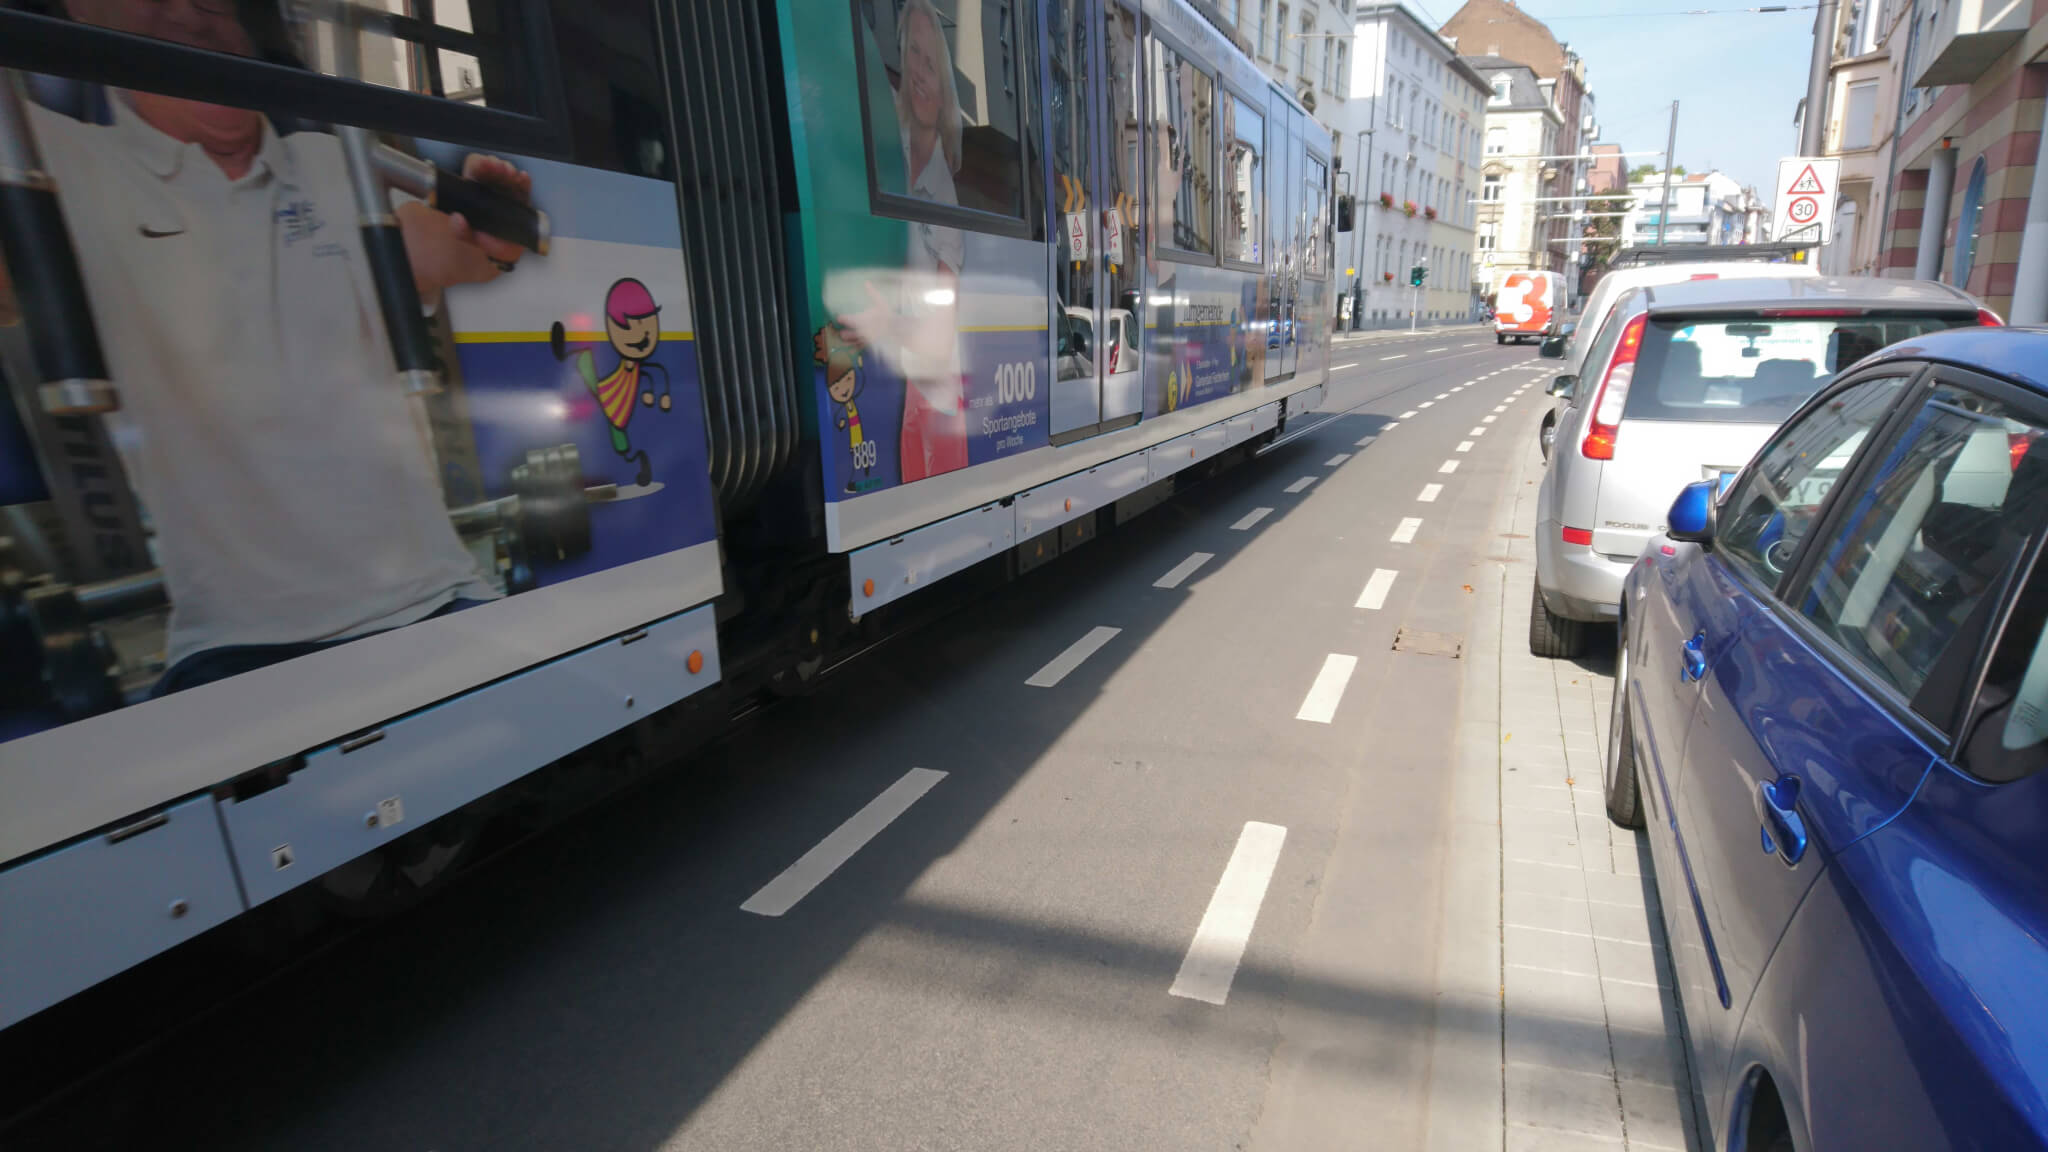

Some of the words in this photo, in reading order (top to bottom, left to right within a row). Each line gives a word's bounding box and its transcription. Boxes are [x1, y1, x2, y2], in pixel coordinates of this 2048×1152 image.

[1794, 203, 1813, 217] 30
[1497, 272, 1548, 331] 3
[994, 361, 1035, 404] 1000
[982, 409, 1037, 438] Sportangebote
[853, 440, 876, 470] 889
